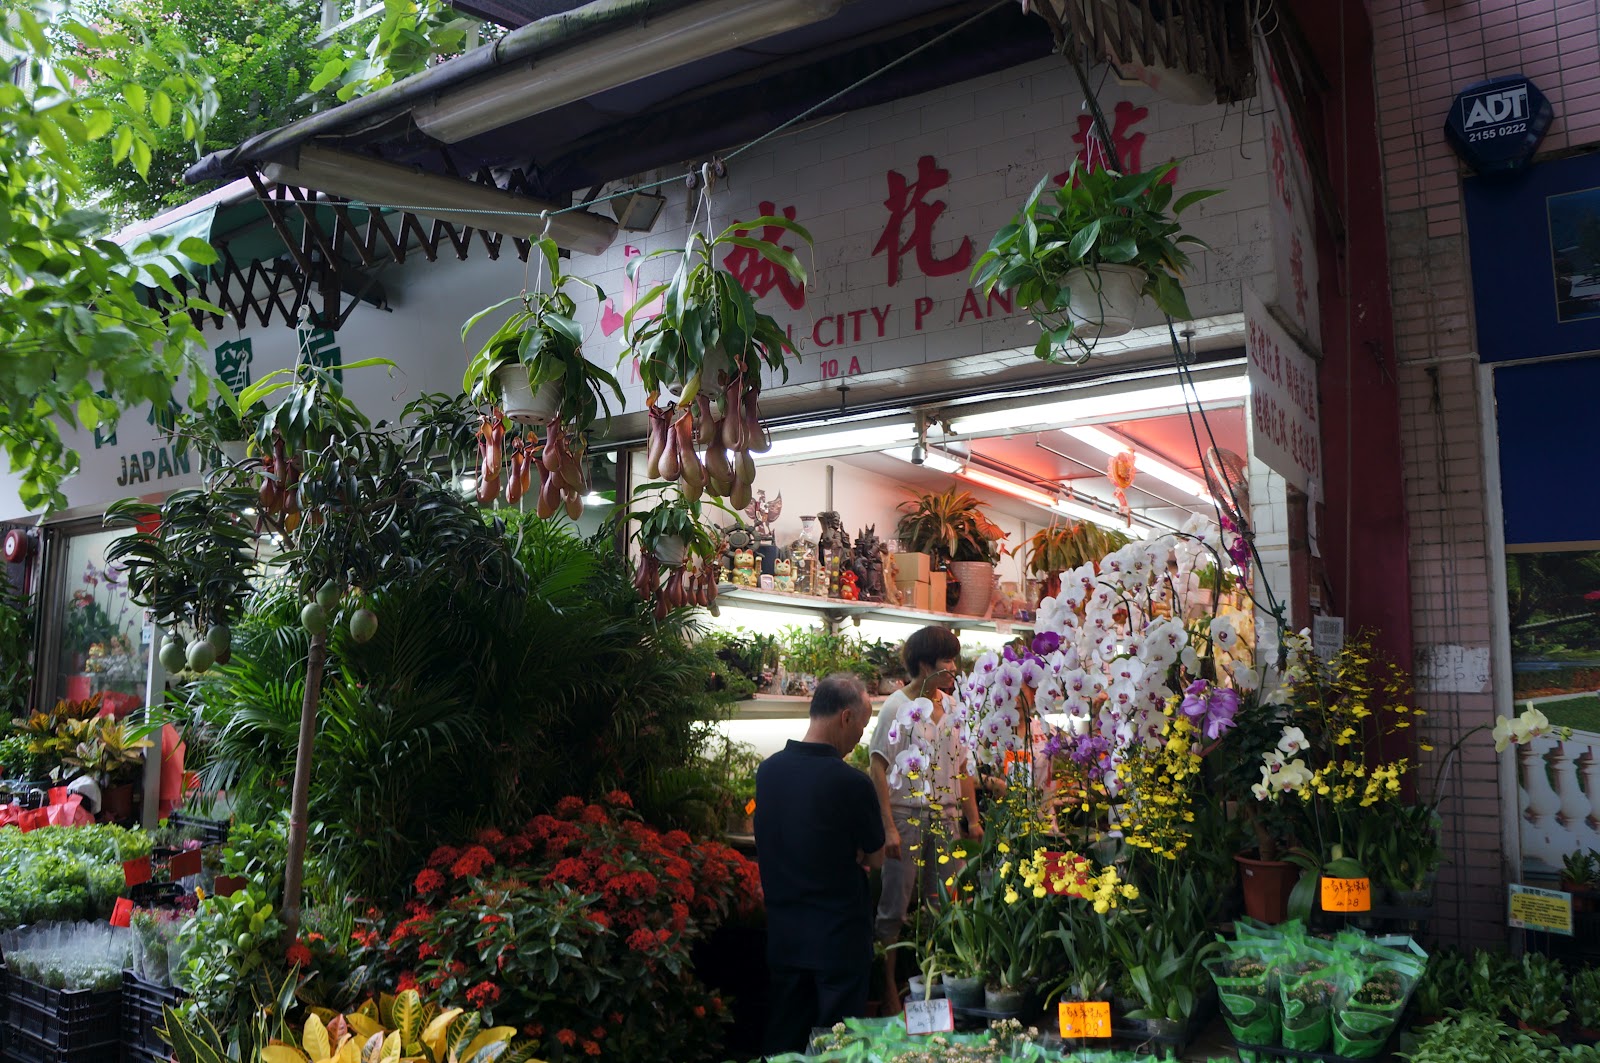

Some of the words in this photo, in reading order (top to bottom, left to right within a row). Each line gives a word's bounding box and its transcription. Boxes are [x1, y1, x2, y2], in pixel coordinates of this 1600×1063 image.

[1464, 86, 1527, 128] ADT
[1469, 130, 1496, 143] 2155
[1499, 122, 1527, 137] 0222
[812, 304, 892, 348] CITY
[116, 444, 191, 487] JAPAN
